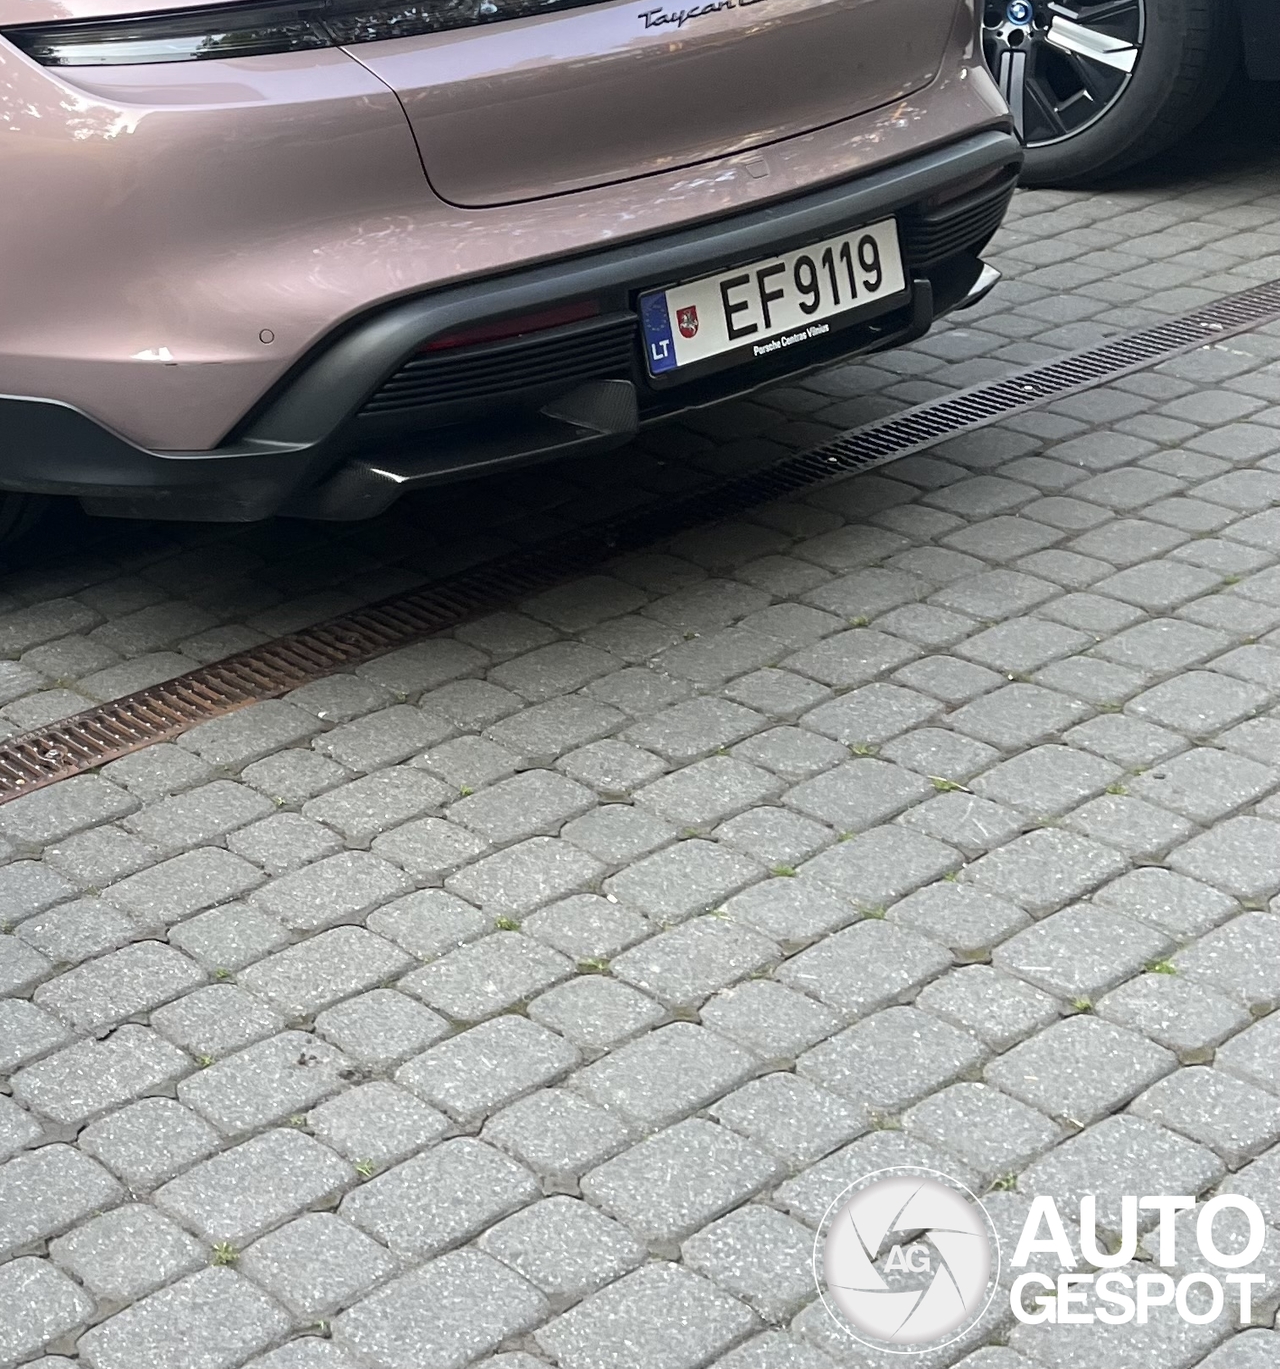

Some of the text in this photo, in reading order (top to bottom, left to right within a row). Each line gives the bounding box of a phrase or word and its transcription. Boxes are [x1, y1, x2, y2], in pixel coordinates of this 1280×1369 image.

[637, 0, 736, 29] Taycan
[720, 234, 882, 340] EF9119
[651, 339, 670, 360] LT
[753, 340, 781, 357] Porsche
[806, 324, 830, 338] Vilnius
